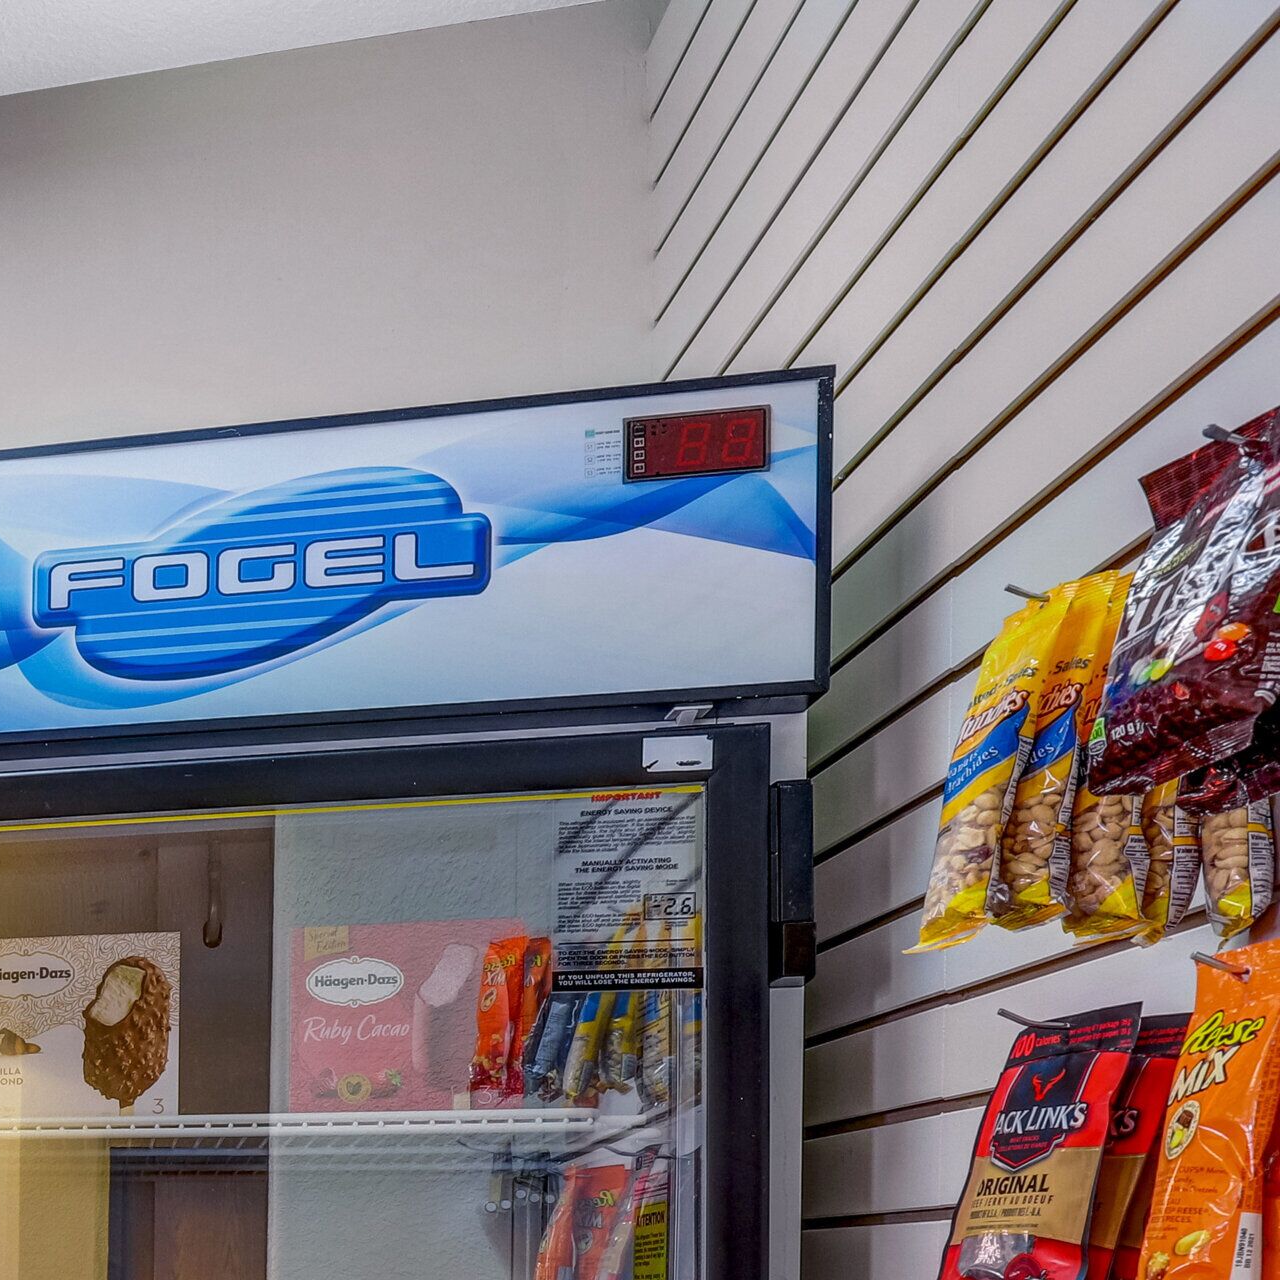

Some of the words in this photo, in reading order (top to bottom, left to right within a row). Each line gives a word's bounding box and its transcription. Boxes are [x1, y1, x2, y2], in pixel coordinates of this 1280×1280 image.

[49, 529, 476, 609] FOGEL
[591, 791, 663, 802] IMPORTANT
[580, 808, 612, 818] ENERGY
[614, 806, 643, 816] SAVING
[644, 805, 674, 814] DEVICE
[591, 865, 624, 874] ENERGY
[655, 863, 679, 871] MODE
[622, 857, 672, 865] ACTIVATING
[314, 973, 399, 988] Häagen-Dazs
[303, 1015, 352, 1047] Ruby
[356, 1014, 410, 1041] Cacao
[1182, 1011, 1265, 1054] Reese
[1010, 1032, 1036, 1059] 100
[152, 1098, 164, 1114] 3
